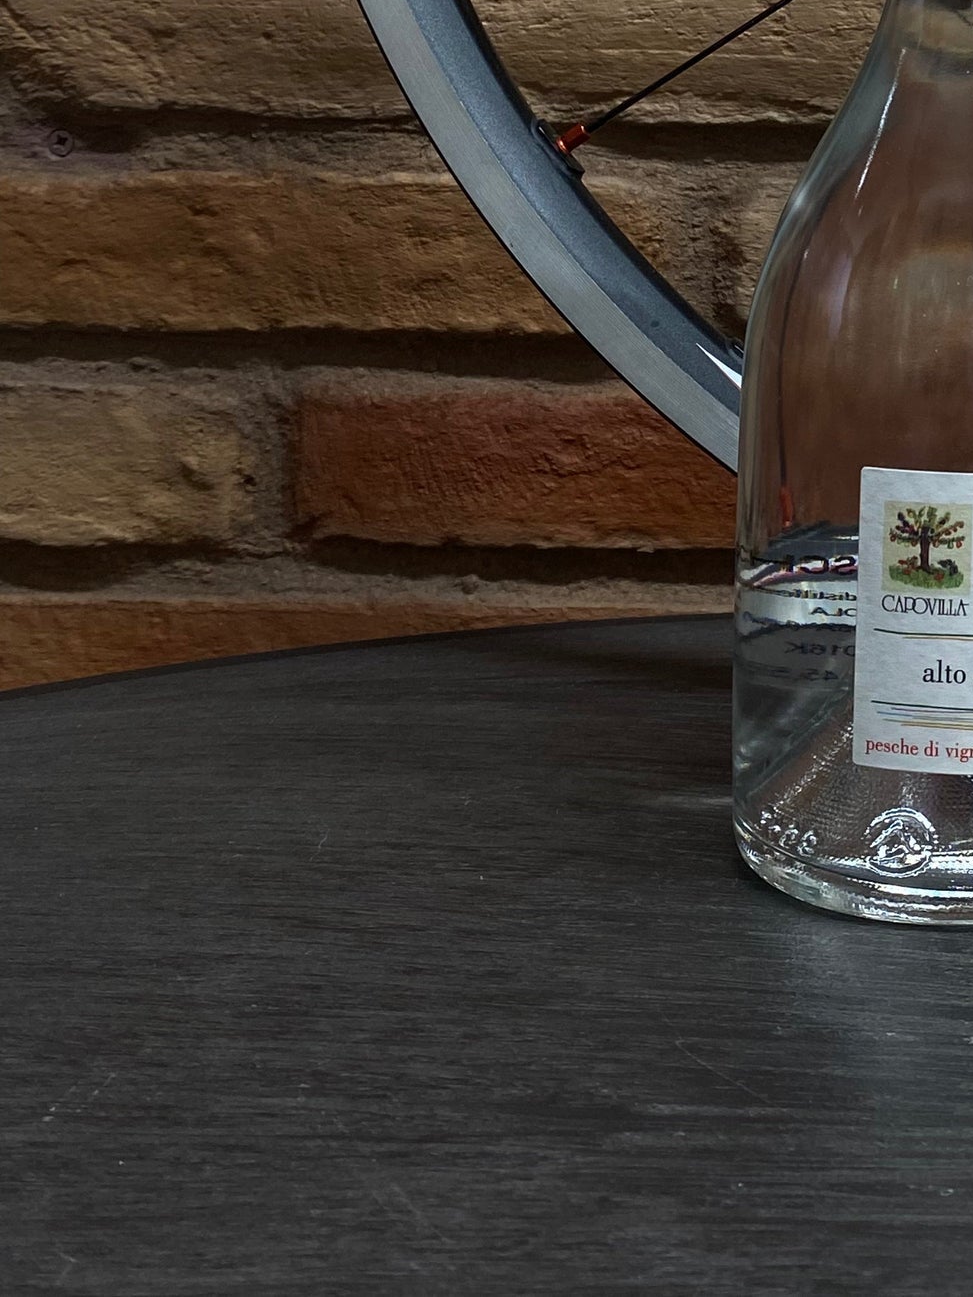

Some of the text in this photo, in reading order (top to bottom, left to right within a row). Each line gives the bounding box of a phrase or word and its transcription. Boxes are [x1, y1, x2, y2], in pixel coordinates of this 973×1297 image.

[881, 594, 970, 617] CAPOVILLA
[922, 659, 967, 685] alto
[865, 737, 919, 756] pesche
[924, 740, 939, 757] di
